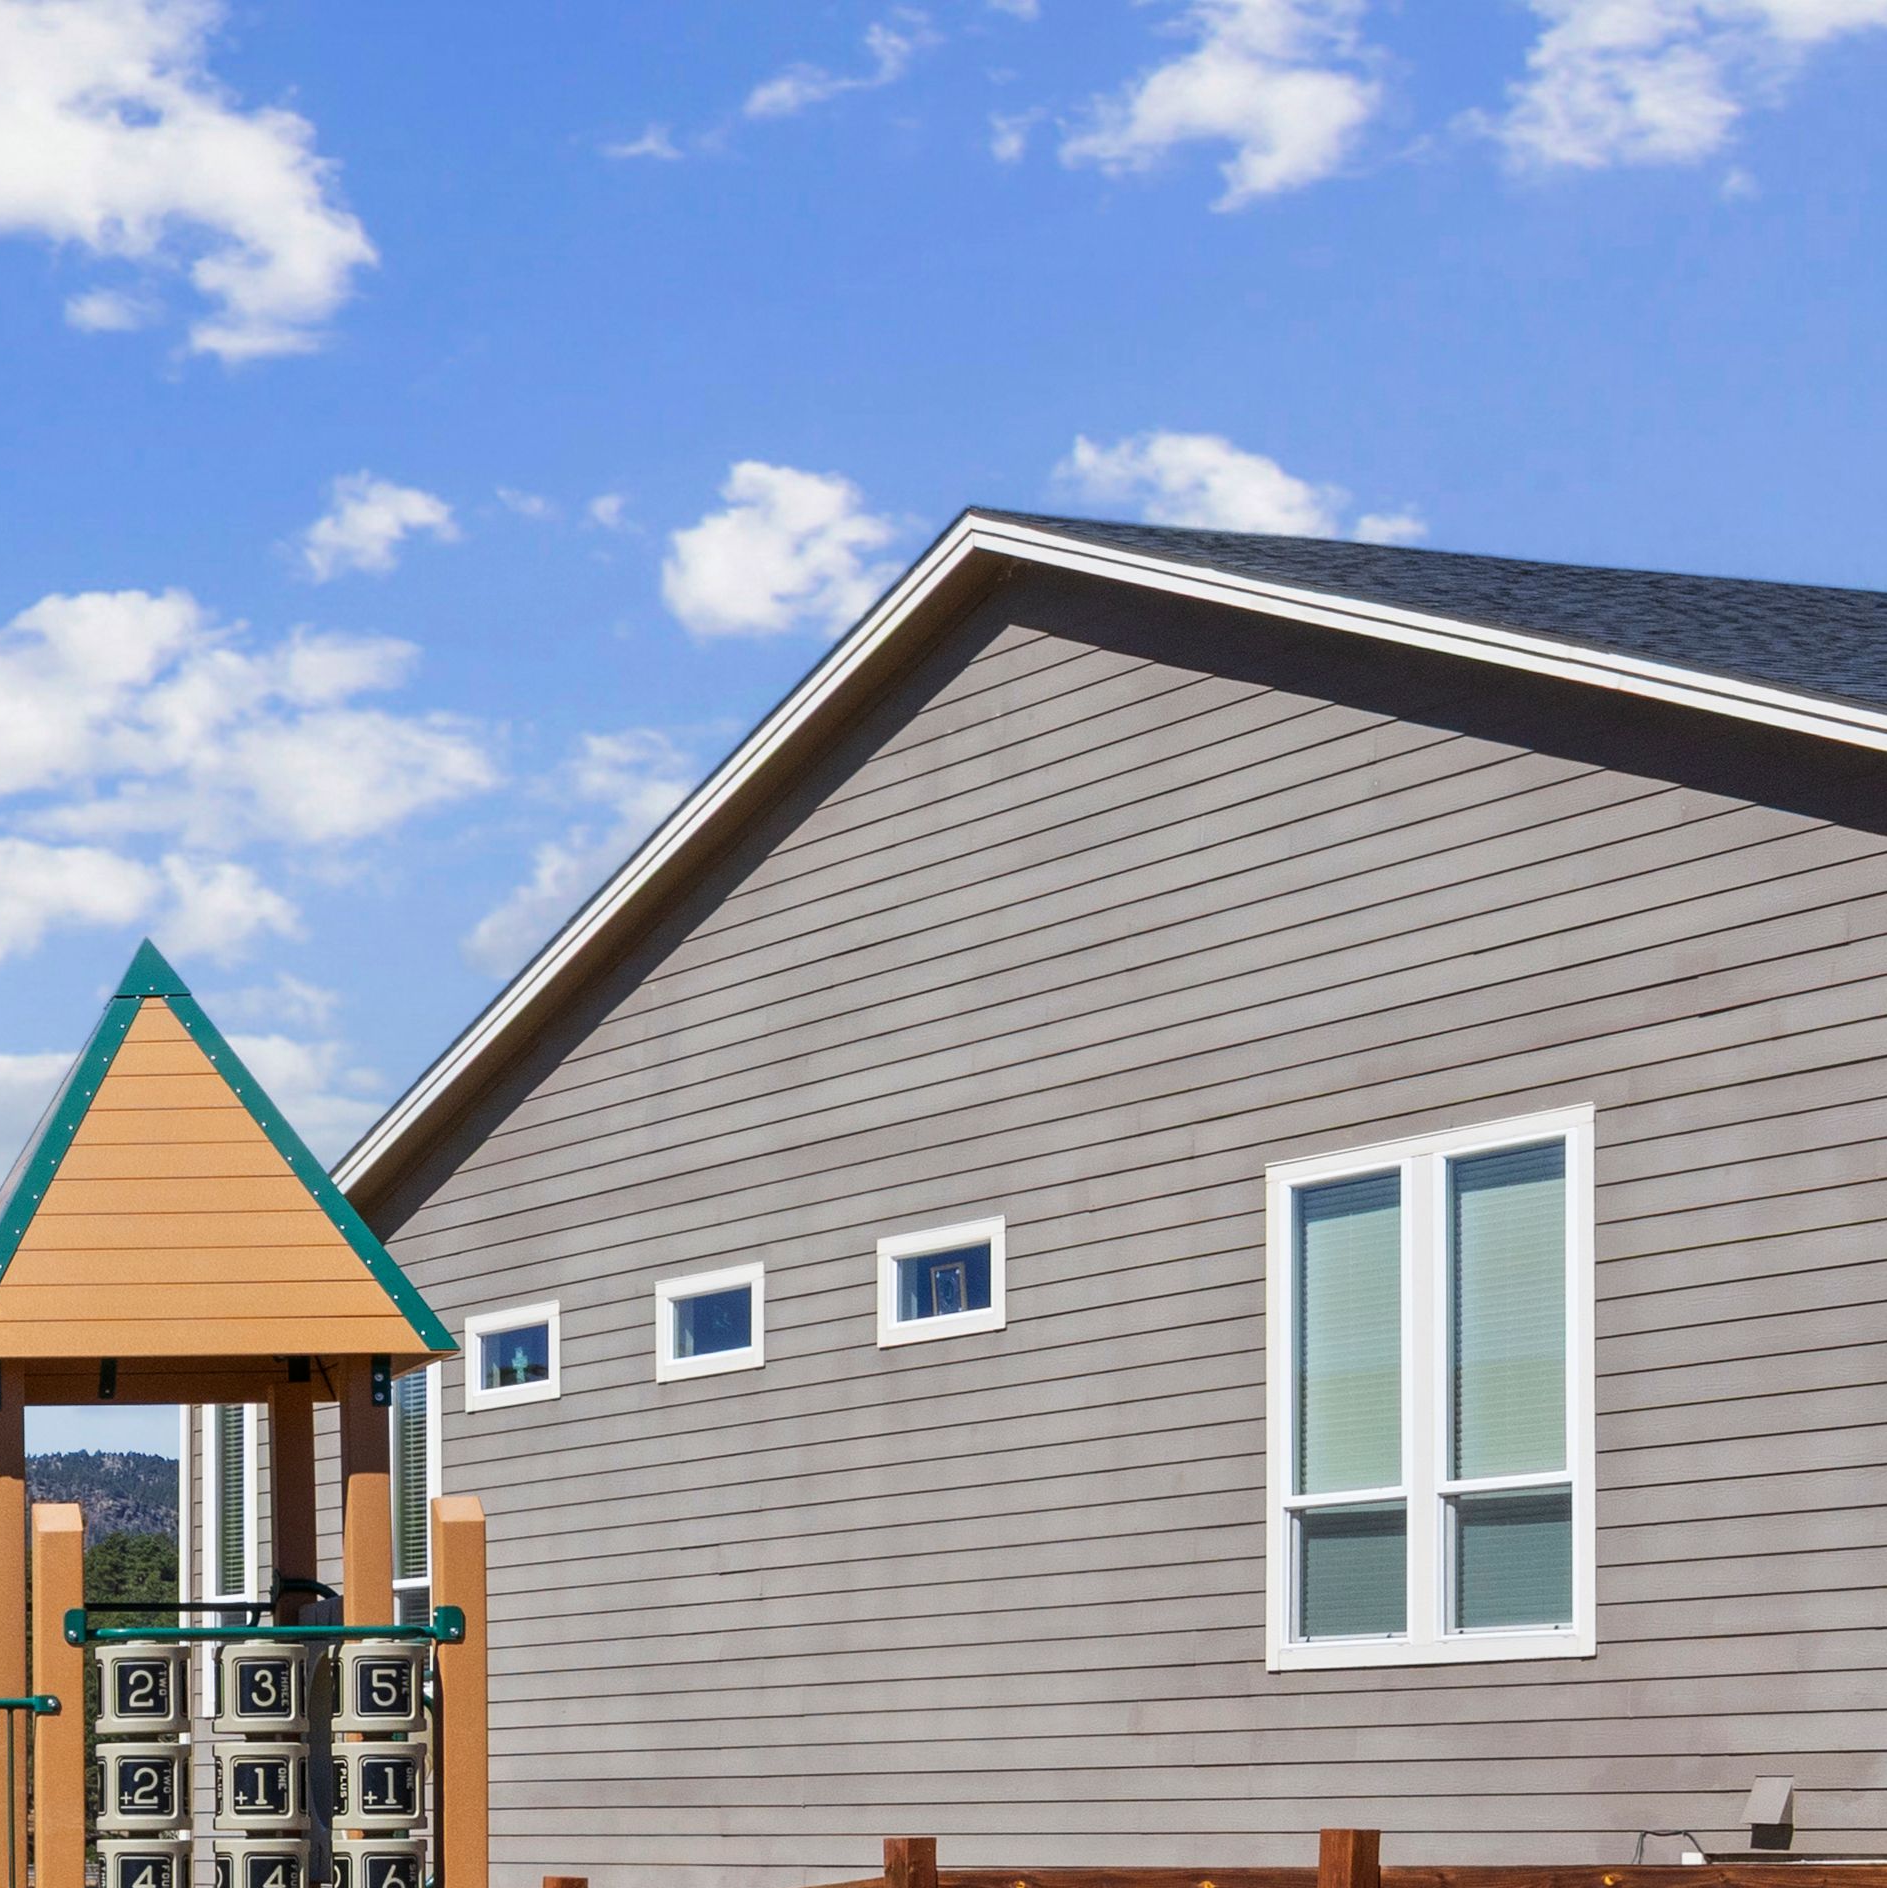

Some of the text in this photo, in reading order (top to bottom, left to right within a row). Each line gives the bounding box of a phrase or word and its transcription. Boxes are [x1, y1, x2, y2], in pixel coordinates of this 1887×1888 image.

[129, 1670, 154, 1707] 2
[158, 1671, 167, 1696] TWO
[251, 1669, 276, 1707] 3
[280, 1671, 289, 1707] THREE
[372, 1668, 397, 1707] 5
[163, 1769, 172, 1794] TWO
[277, 1767, 287, 1790] ONE
[339, 1767, 347, 1798] PLUS
[406, 1767, 415, 1790] ONE
[408, 1863, 417, 1882] SIX
